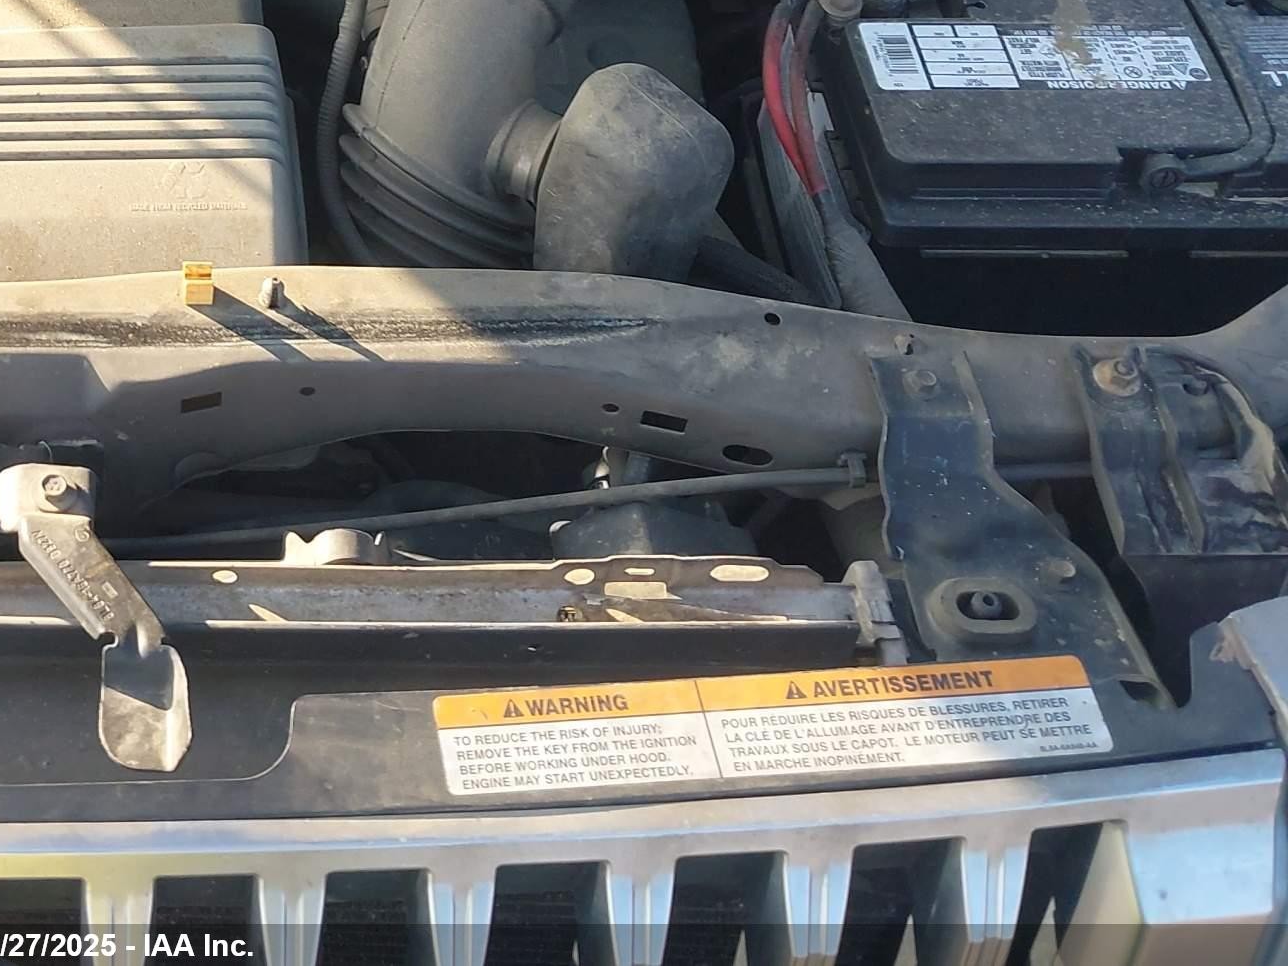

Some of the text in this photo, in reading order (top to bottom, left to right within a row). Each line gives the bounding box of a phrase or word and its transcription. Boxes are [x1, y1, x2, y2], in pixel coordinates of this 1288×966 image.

[812, 670, 993, 698] AVERTISSEMENT
[525, 693, 629, 717] WARNING
[721, 697, 1069, 729] POUR RÉDUIRE LES RISQUES DE BLESSURES, RETIRER
[453, 735, 473, 748] TO
[475, 731, 528, 746] REDUCE
[530, 729, 556, 743] THE
[559, 727, 590, 741] RISK
[592, 726, 610, 739] OF
[724, 711, 1071, 743] LA CLÉ DE L'ALLUMAGE AVANT D'ENTREPRENDRE DES
[457, 734, 696, 761] REMOVE THE KEY FROM THE IGNITION
[730, 724, 1092, 759] TRAVAUX SOUS LE CAPOT. LE MOTEUR PEUT SE METTRE
[460, 751, 670, 776] BEFORE WORKING UNDER HOOD.
[734, 760, 752, 772] EN
[754, 756, 811, 771] MARCHE
[463, 764, 694, 790] ENGINE MAY START UNEXPECTEDLY.
